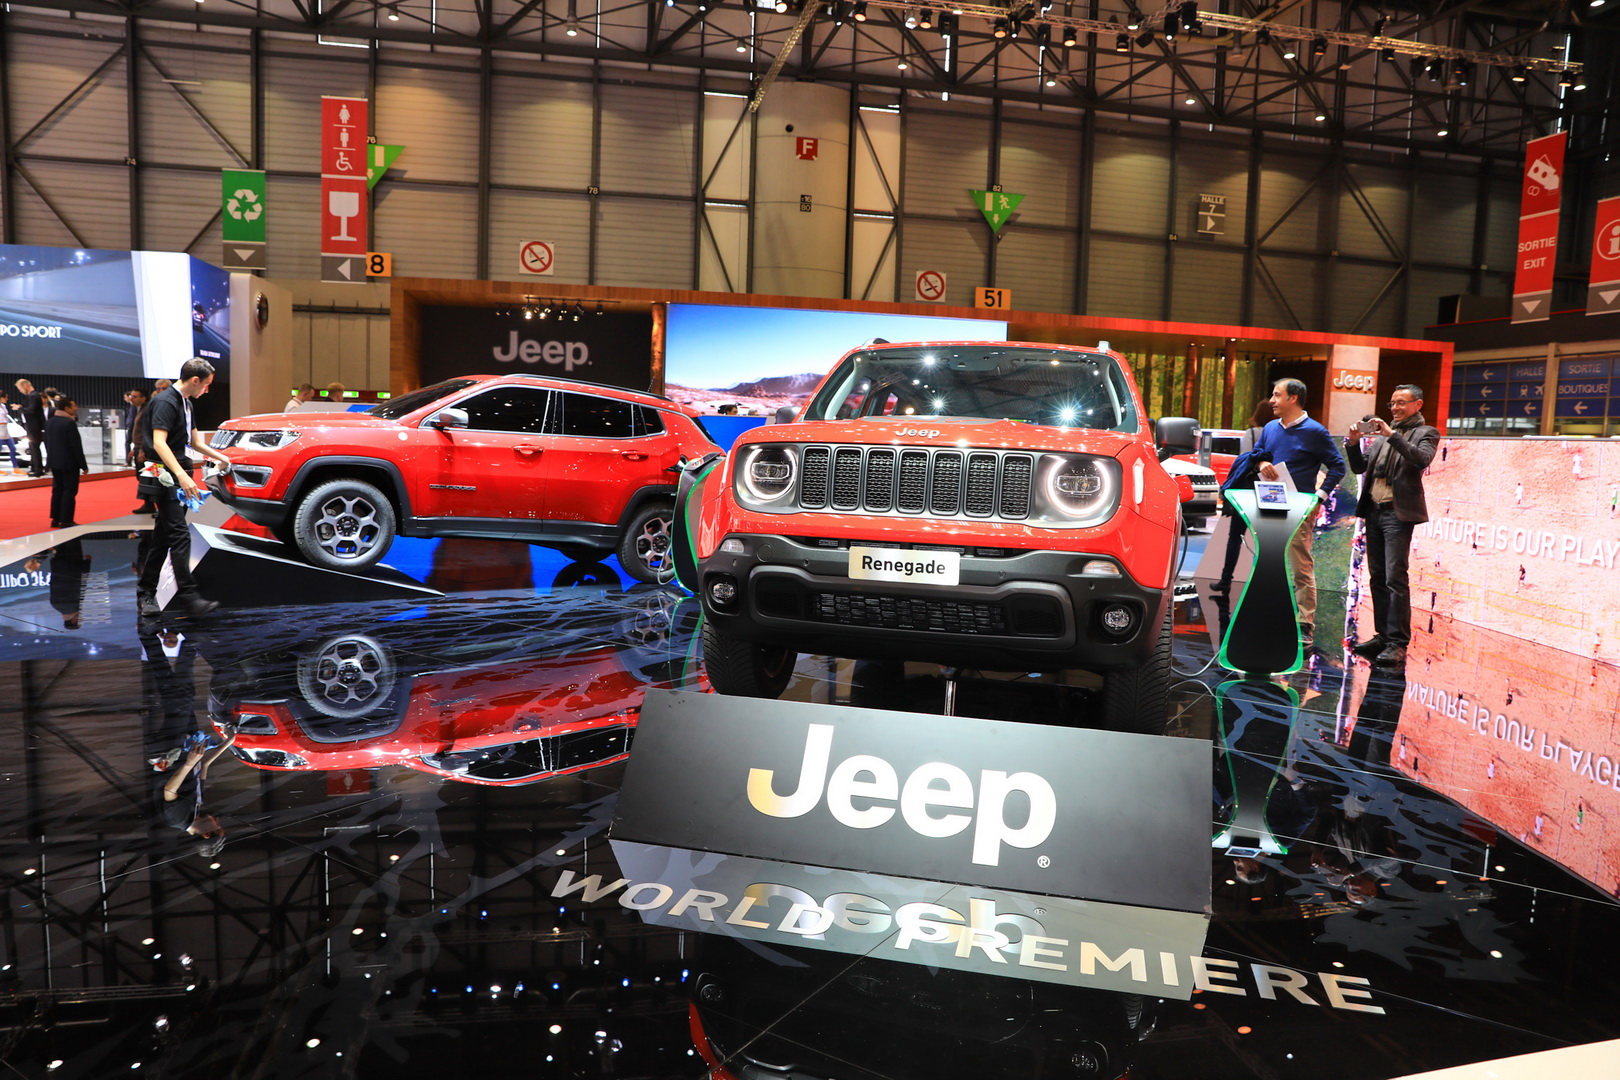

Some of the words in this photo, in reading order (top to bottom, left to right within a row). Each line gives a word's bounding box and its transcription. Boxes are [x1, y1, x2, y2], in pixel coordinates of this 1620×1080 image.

[802, 139, 814, 155] F
[588, 186, 599, 195] 78
[1201, 196, 1225, 205] HALLE
[1209, 204, 1216, 214] 7
[1517, 236, 1557, 253] SORTIE
[366, 254, 385, 274] 8
[1523, 256, 1547, 270] EXIT
[984, 289, 1003, 308] 51
[21, 325, 63, 339] SPORT
[1515, 366, 1545, 377] HALLE
[1568, 363, 1602, 375] SORTIE
[1558, 383, 1609, 394] BOUTIQUES
[895, 427, 941, 440] Jeep
[1422, 515, 1487, 548] NATURE
[1490, 524, 1509, 551] IS
[1512, 527, 1557, 559] OUR
[861, 555, 946, 577] Renegade
[550, 869, 837, 937] WORLD
[894, 919, 1387, 1016] PREMIERE
